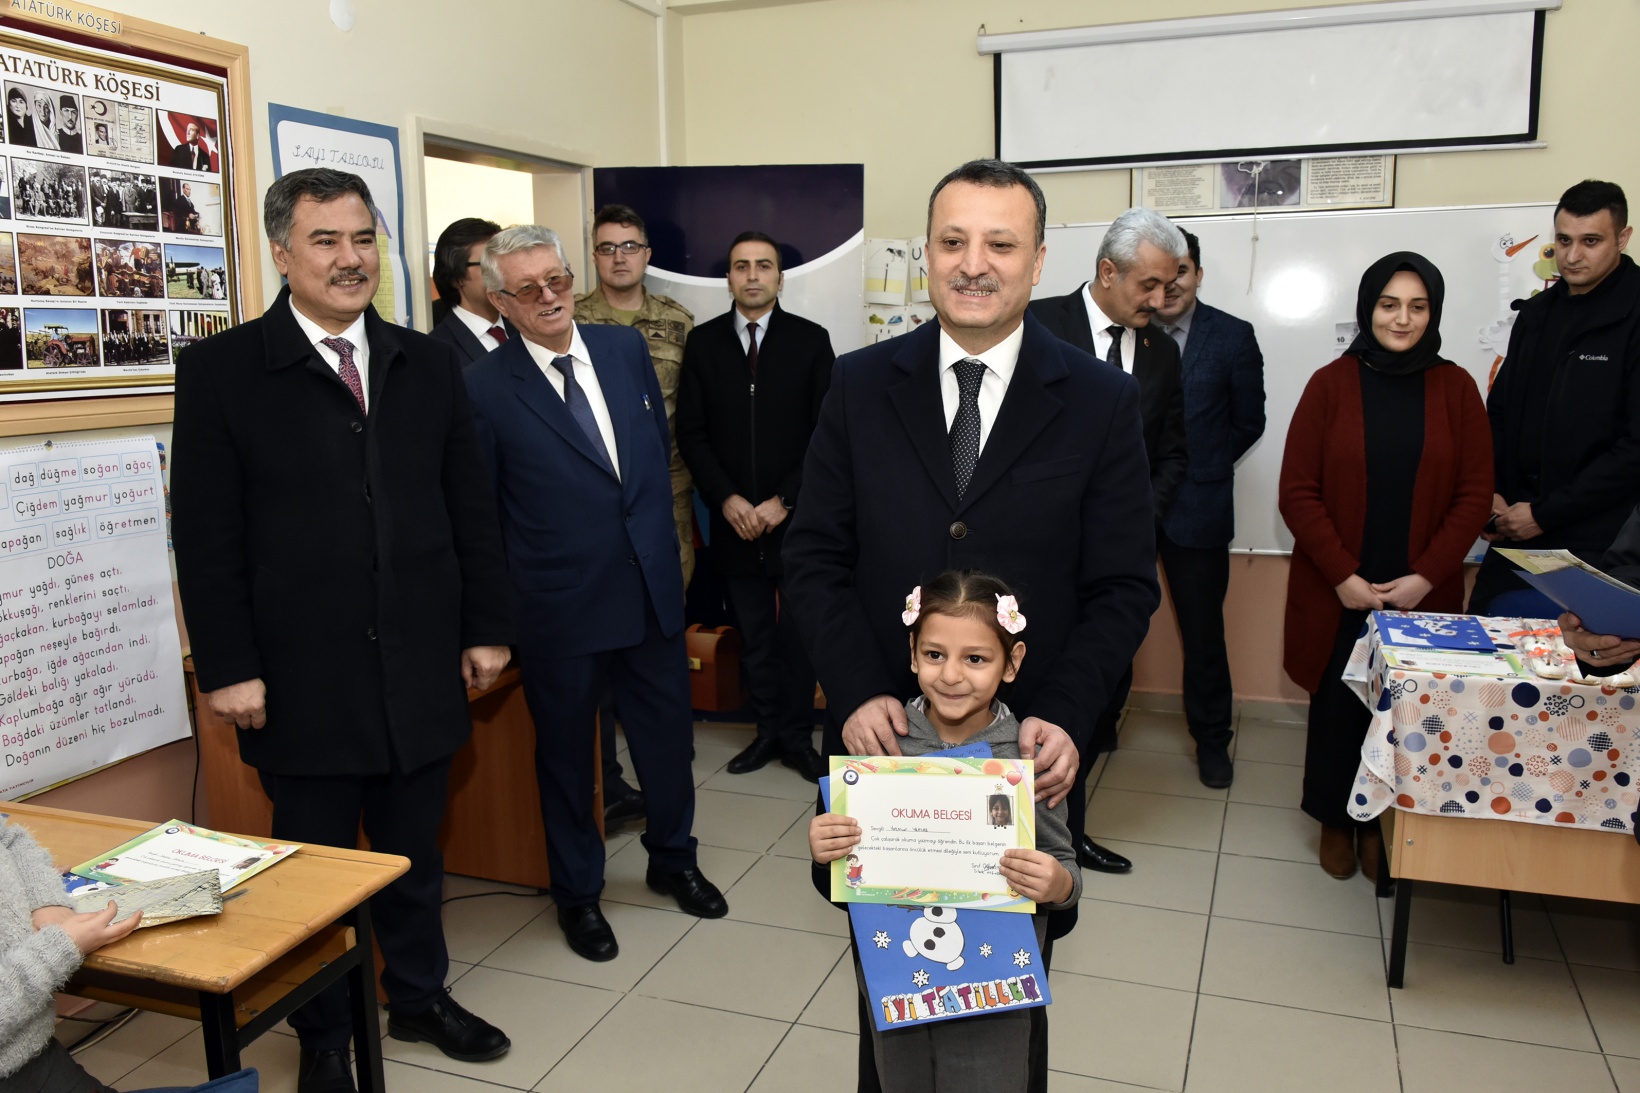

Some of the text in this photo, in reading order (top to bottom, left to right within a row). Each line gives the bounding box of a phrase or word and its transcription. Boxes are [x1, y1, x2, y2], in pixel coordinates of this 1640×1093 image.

[11, 0, 121, 35] ATATÜRK KÖŞESİ
[0, 53, 161, 102] ATATÜRK KÖŞESİ
[15, 460, 152, 487] dağ düğme soğan ağaç
[16, 486, 154, 517] Çiğdem yağmur yoğurt
[55, 522, 87, 541] sağlık
[99, 517, 157, 535] öğretmen
[47, 550, 84, 570] DOĞA
[29, 577, 60, 599] yağdı,
[65, 573, 95, 590] güneş
[100, 566, 122, 579] açtı.
[48, 590, 97, 610] renklerini
[102, 584, 130, 597] saçtı.
[52, 610, 102, 629] kurbağayı
[107, 594, 159, 615] selamladı.
[40, 632, 78, 652] neşeyle
[81, 621, 121, 642] bağırdı.
[0, 633, 151, 685] urbağa, iğde ağacından indi.
[0, 660, 119, 706] Göldeki balığı yakaladı.
[0, 669, 159, 727] Kaplumbağa ağır ağır yürüdü.
[2, 693, 137, 747] Bağdaki üzümler tatlandı.
[5, 703, 165, 767] Doğanın düzeni hiç bozulmadı.
[891, 808, 972, 820] OKUMA BELGESİ
[882, 974, 1042, 1023] İYİ TATİLLER
